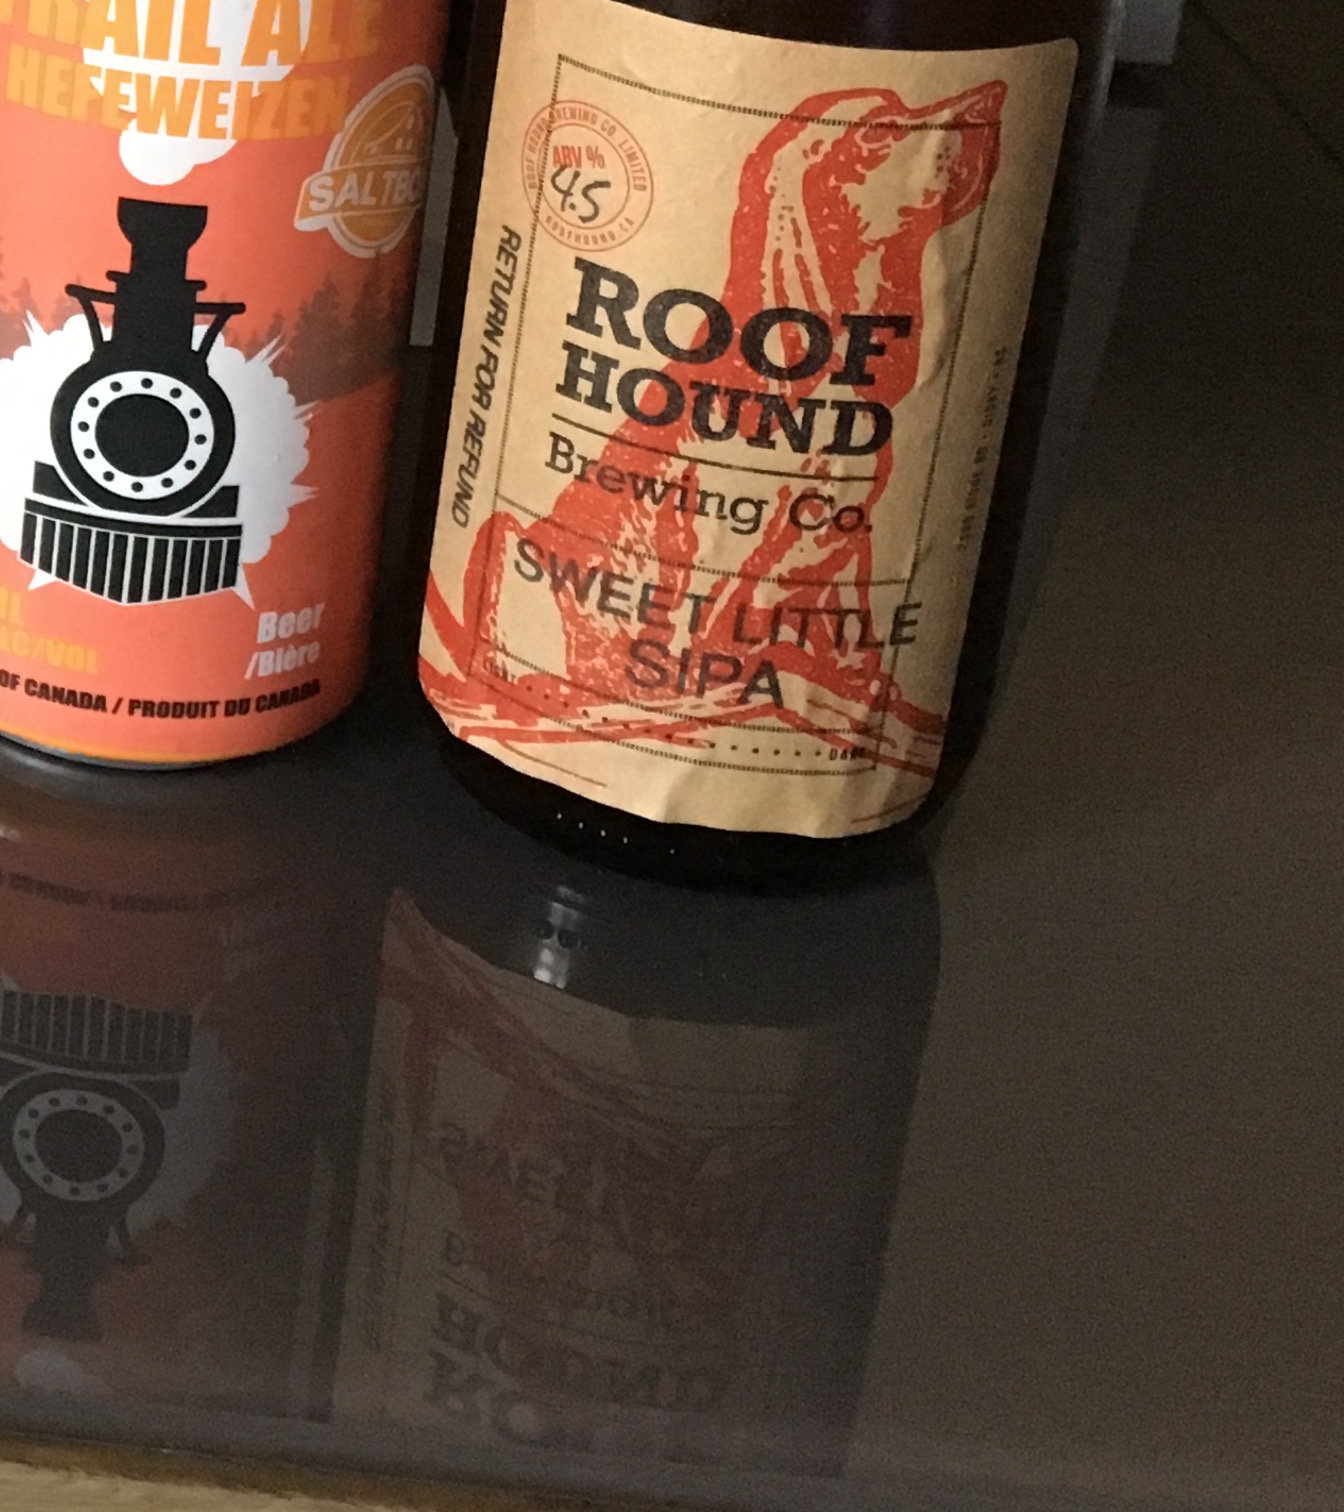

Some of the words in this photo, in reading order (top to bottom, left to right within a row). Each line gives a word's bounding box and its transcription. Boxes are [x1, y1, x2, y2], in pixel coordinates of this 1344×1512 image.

[5, 43, 350, 141] HEFEWEIZEN
[550, 162, 612, 224] 4.5
[553, 145, 582, 169] ABV
[618, 138, 648, 193] LIMITED
[480, 224, 523, 348] RETURN
[564, 255, 912, 386] ROOF
[470, 343, 500, 412] FOR
[554, 341, 894, 458] HOUND
[450, 407, 486, 529] REFUND
[544, 432, 770, 534] Brewing
[788, 491, 874, 534] Co.
[256, 602, 326, 644] Beer
[513, 538, 716, 636] SWEET
[732, 601, 923, 654] LITTLE
[244, 639, 322, 681] /Bière
[624, 634, 786, 709] SIPA
[24, 677, 108, 713] CANADA
[128, 697, 219, 720] PRODUIT
[224, 696, 251, 717] DU
[255, 678, 322, 714] CANADA
